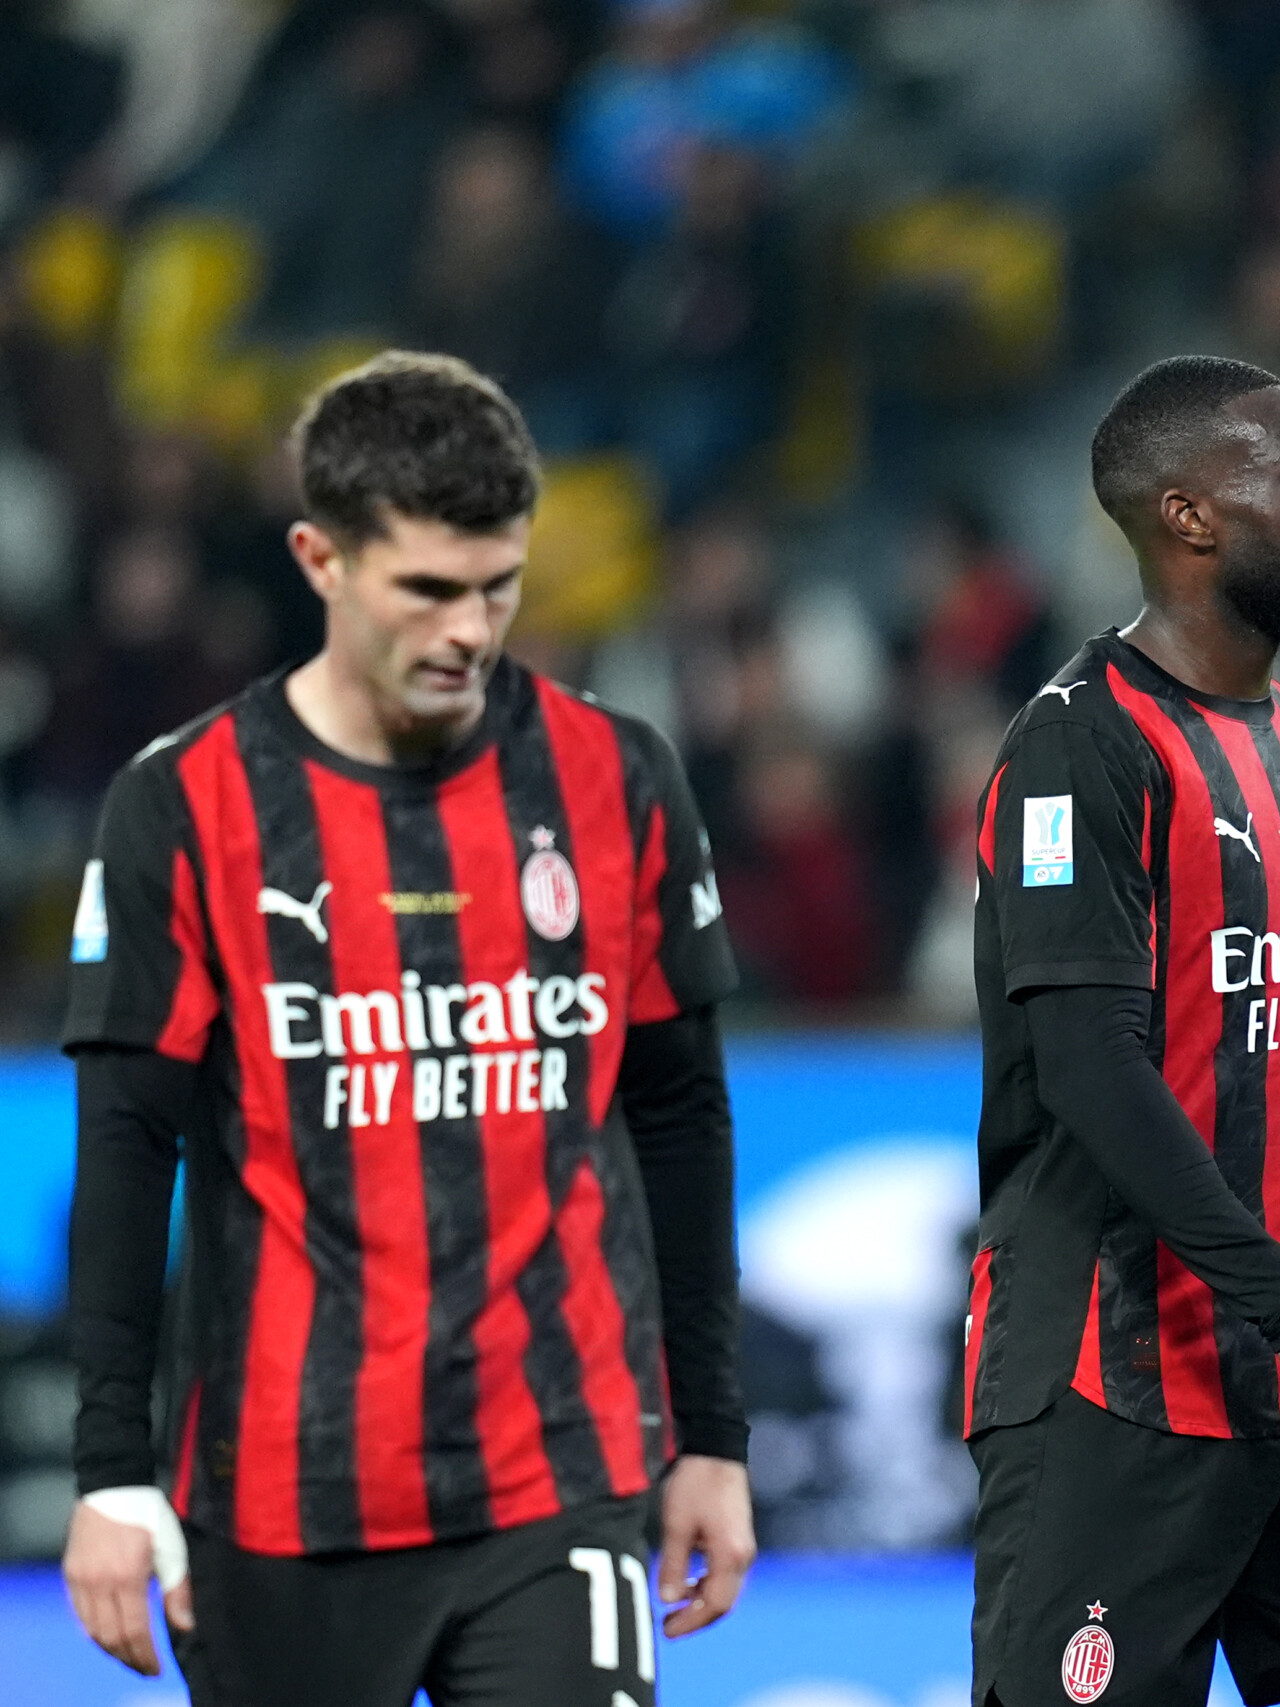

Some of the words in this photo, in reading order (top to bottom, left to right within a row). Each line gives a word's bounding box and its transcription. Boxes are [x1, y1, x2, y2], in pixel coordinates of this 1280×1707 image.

[261, 967, 609, 1060] Emirates
[323, 1060, 400, 1130] FLY
[412, 1047, 569, 1123] BETTER
[568, 1546, 656, 1684] 11
[1079, 1632, 1106, 1647] ACM
[1072, 1683, 1095, 1694] 1899
